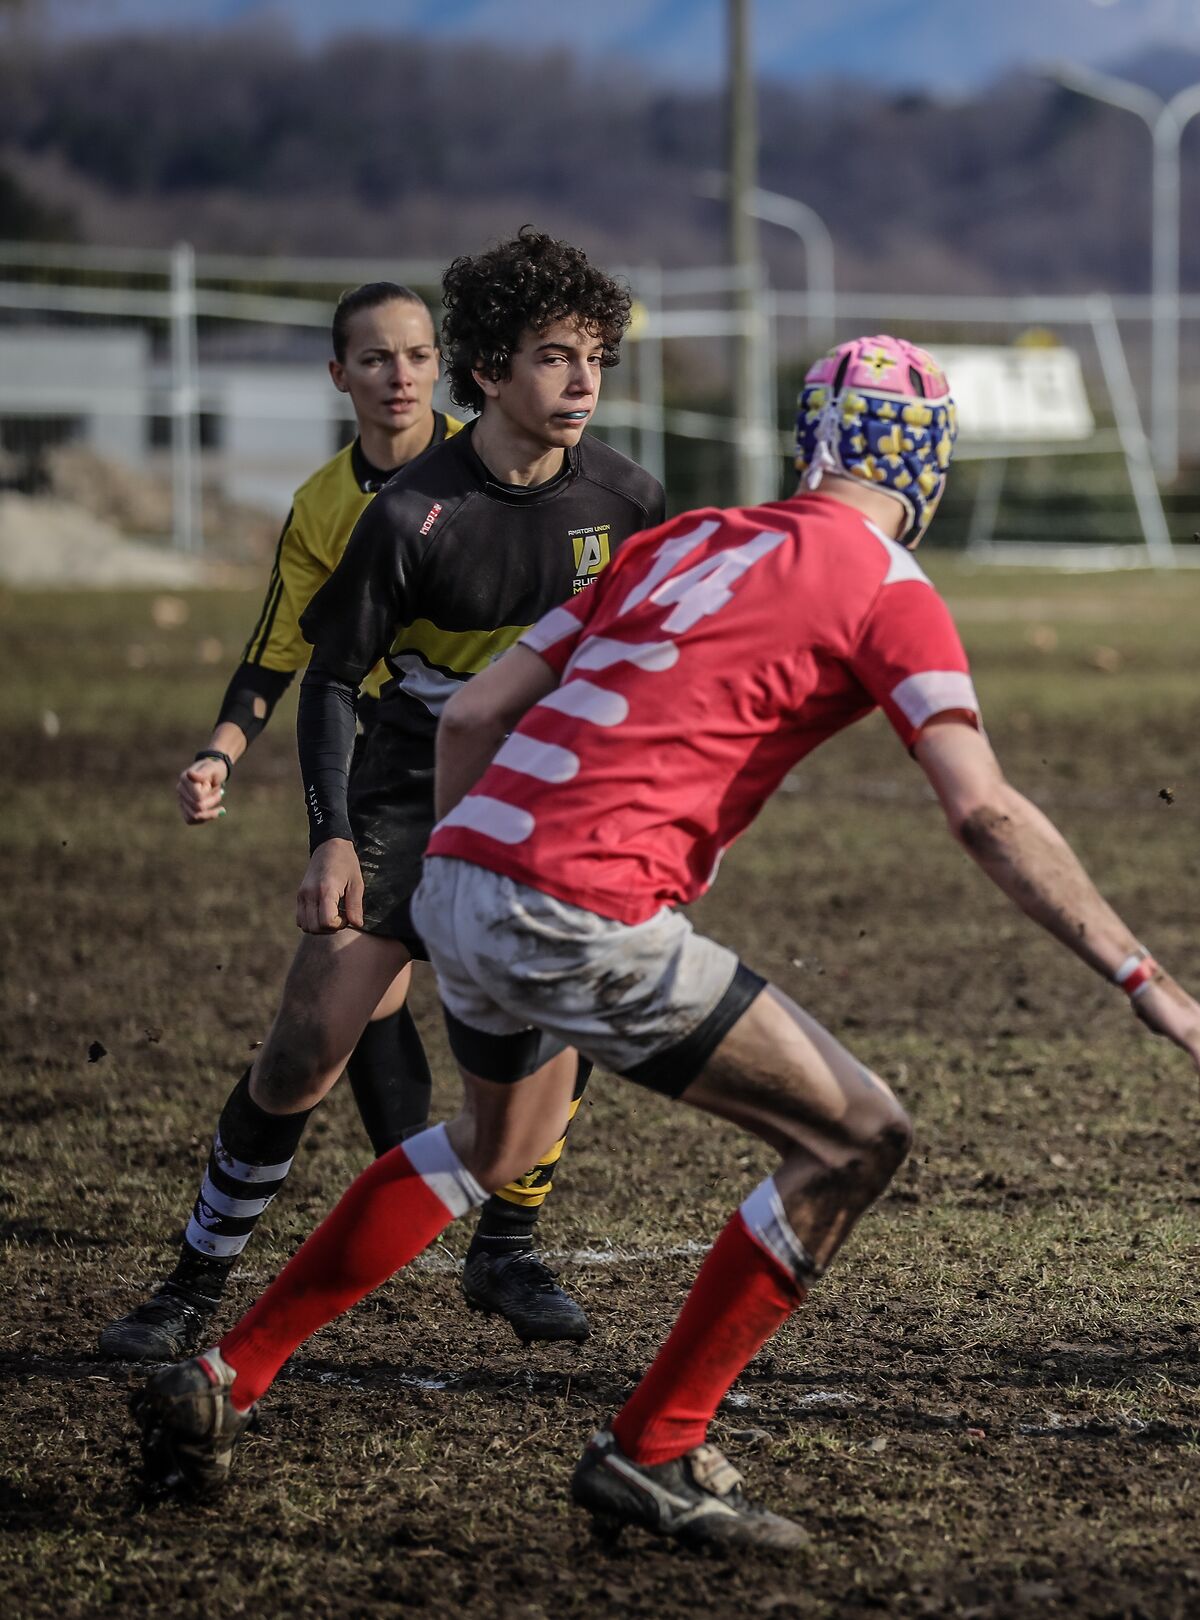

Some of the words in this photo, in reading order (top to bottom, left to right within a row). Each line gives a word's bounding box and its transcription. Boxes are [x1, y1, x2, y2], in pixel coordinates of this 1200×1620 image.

[568, 527, 594, 536] AMATORI
[594, 524, 611, 532] UNION
[617, 520, 788, 634] 14
